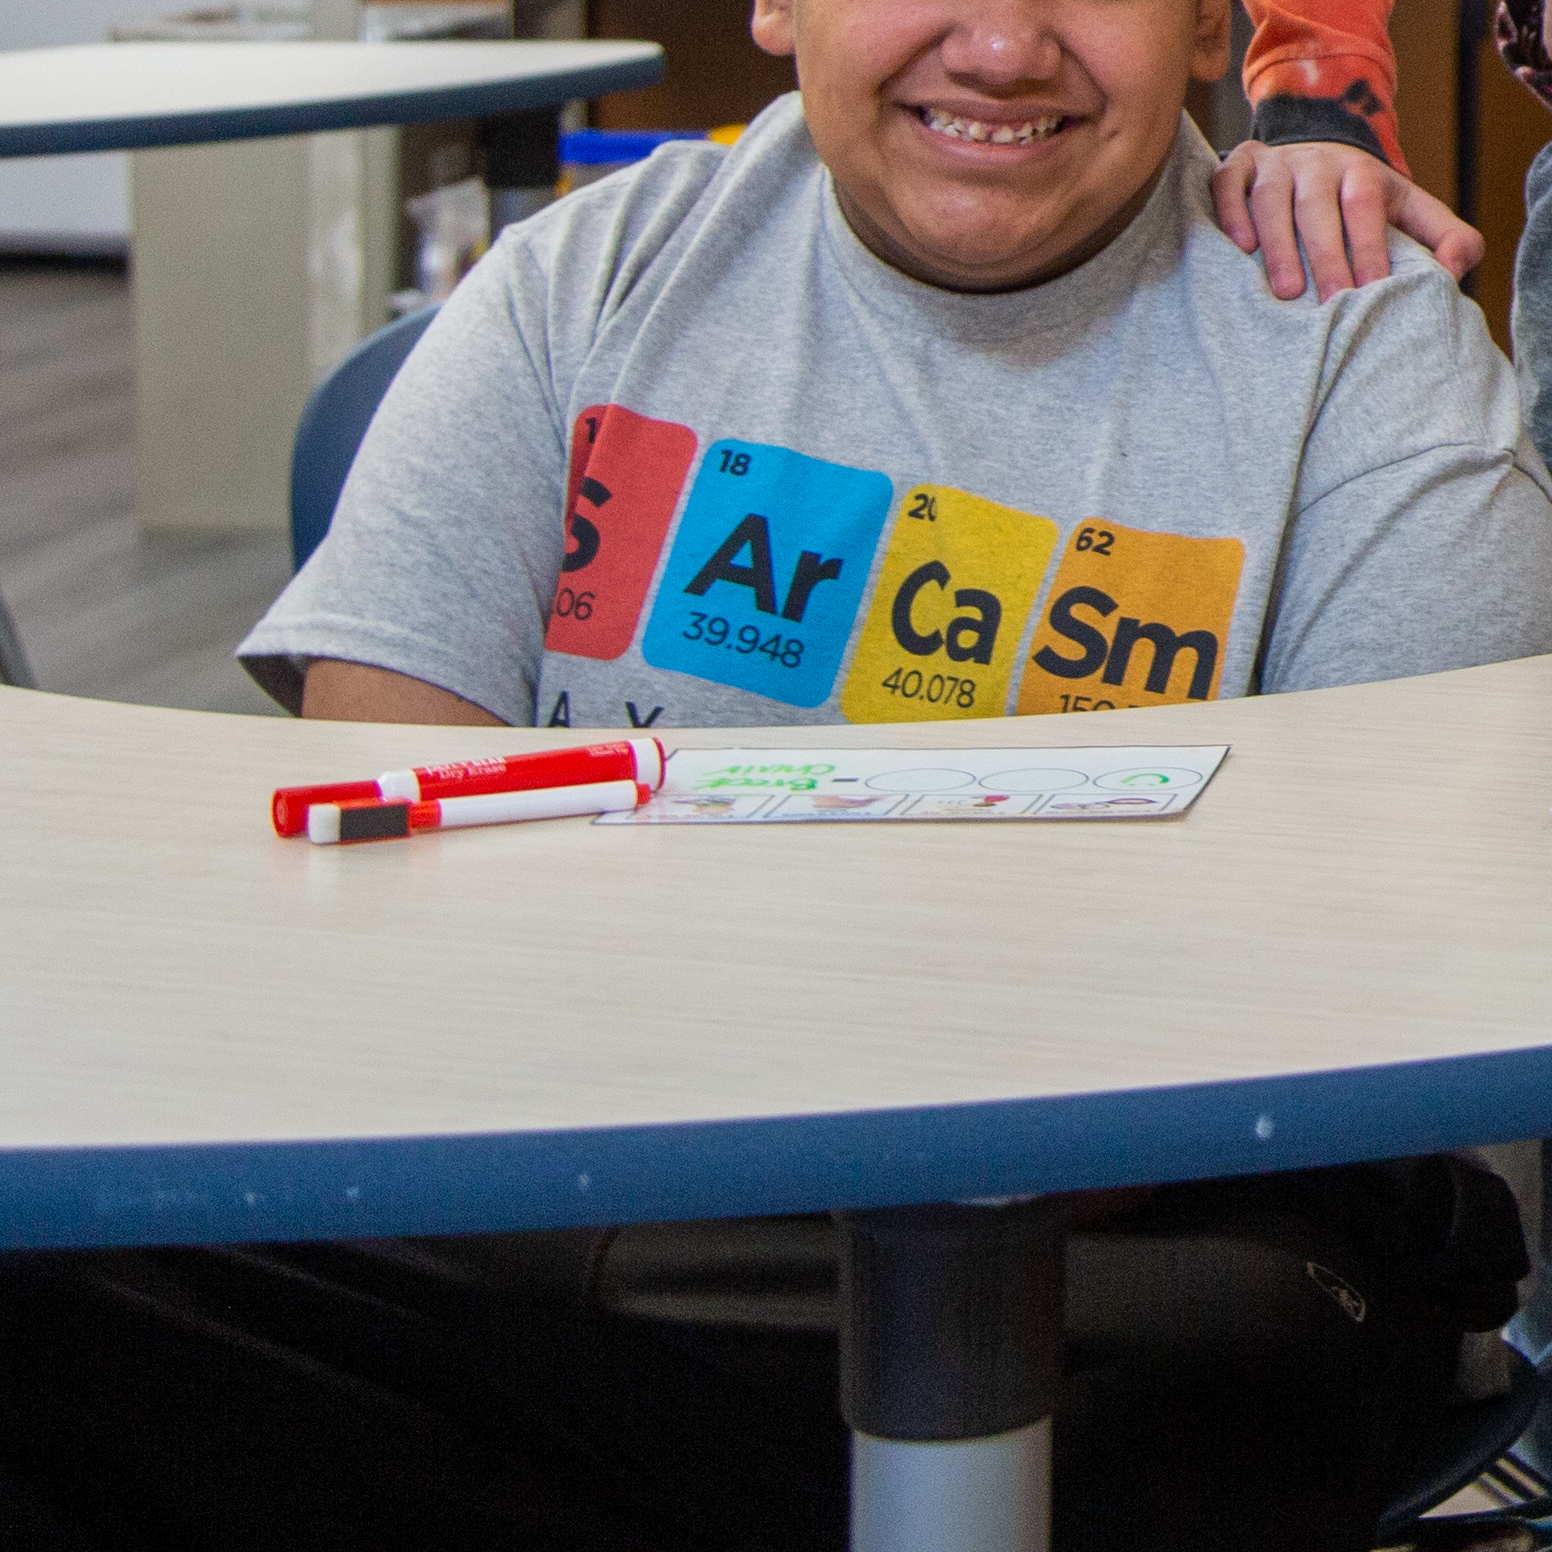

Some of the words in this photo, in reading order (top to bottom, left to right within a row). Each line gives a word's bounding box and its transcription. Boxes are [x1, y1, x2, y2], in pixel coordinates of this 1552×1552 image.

[719, 449, 752, 477] 18
[1075, 527, 1116, 557] 62
[683, 513, 845, 624] Ar
[891, 559, 1003, 666] Ca
[1032, 585, 1219, 701] Sm
[683, 611, 805, 669] 39.948
[882, 667, 977, 709] 40.078
